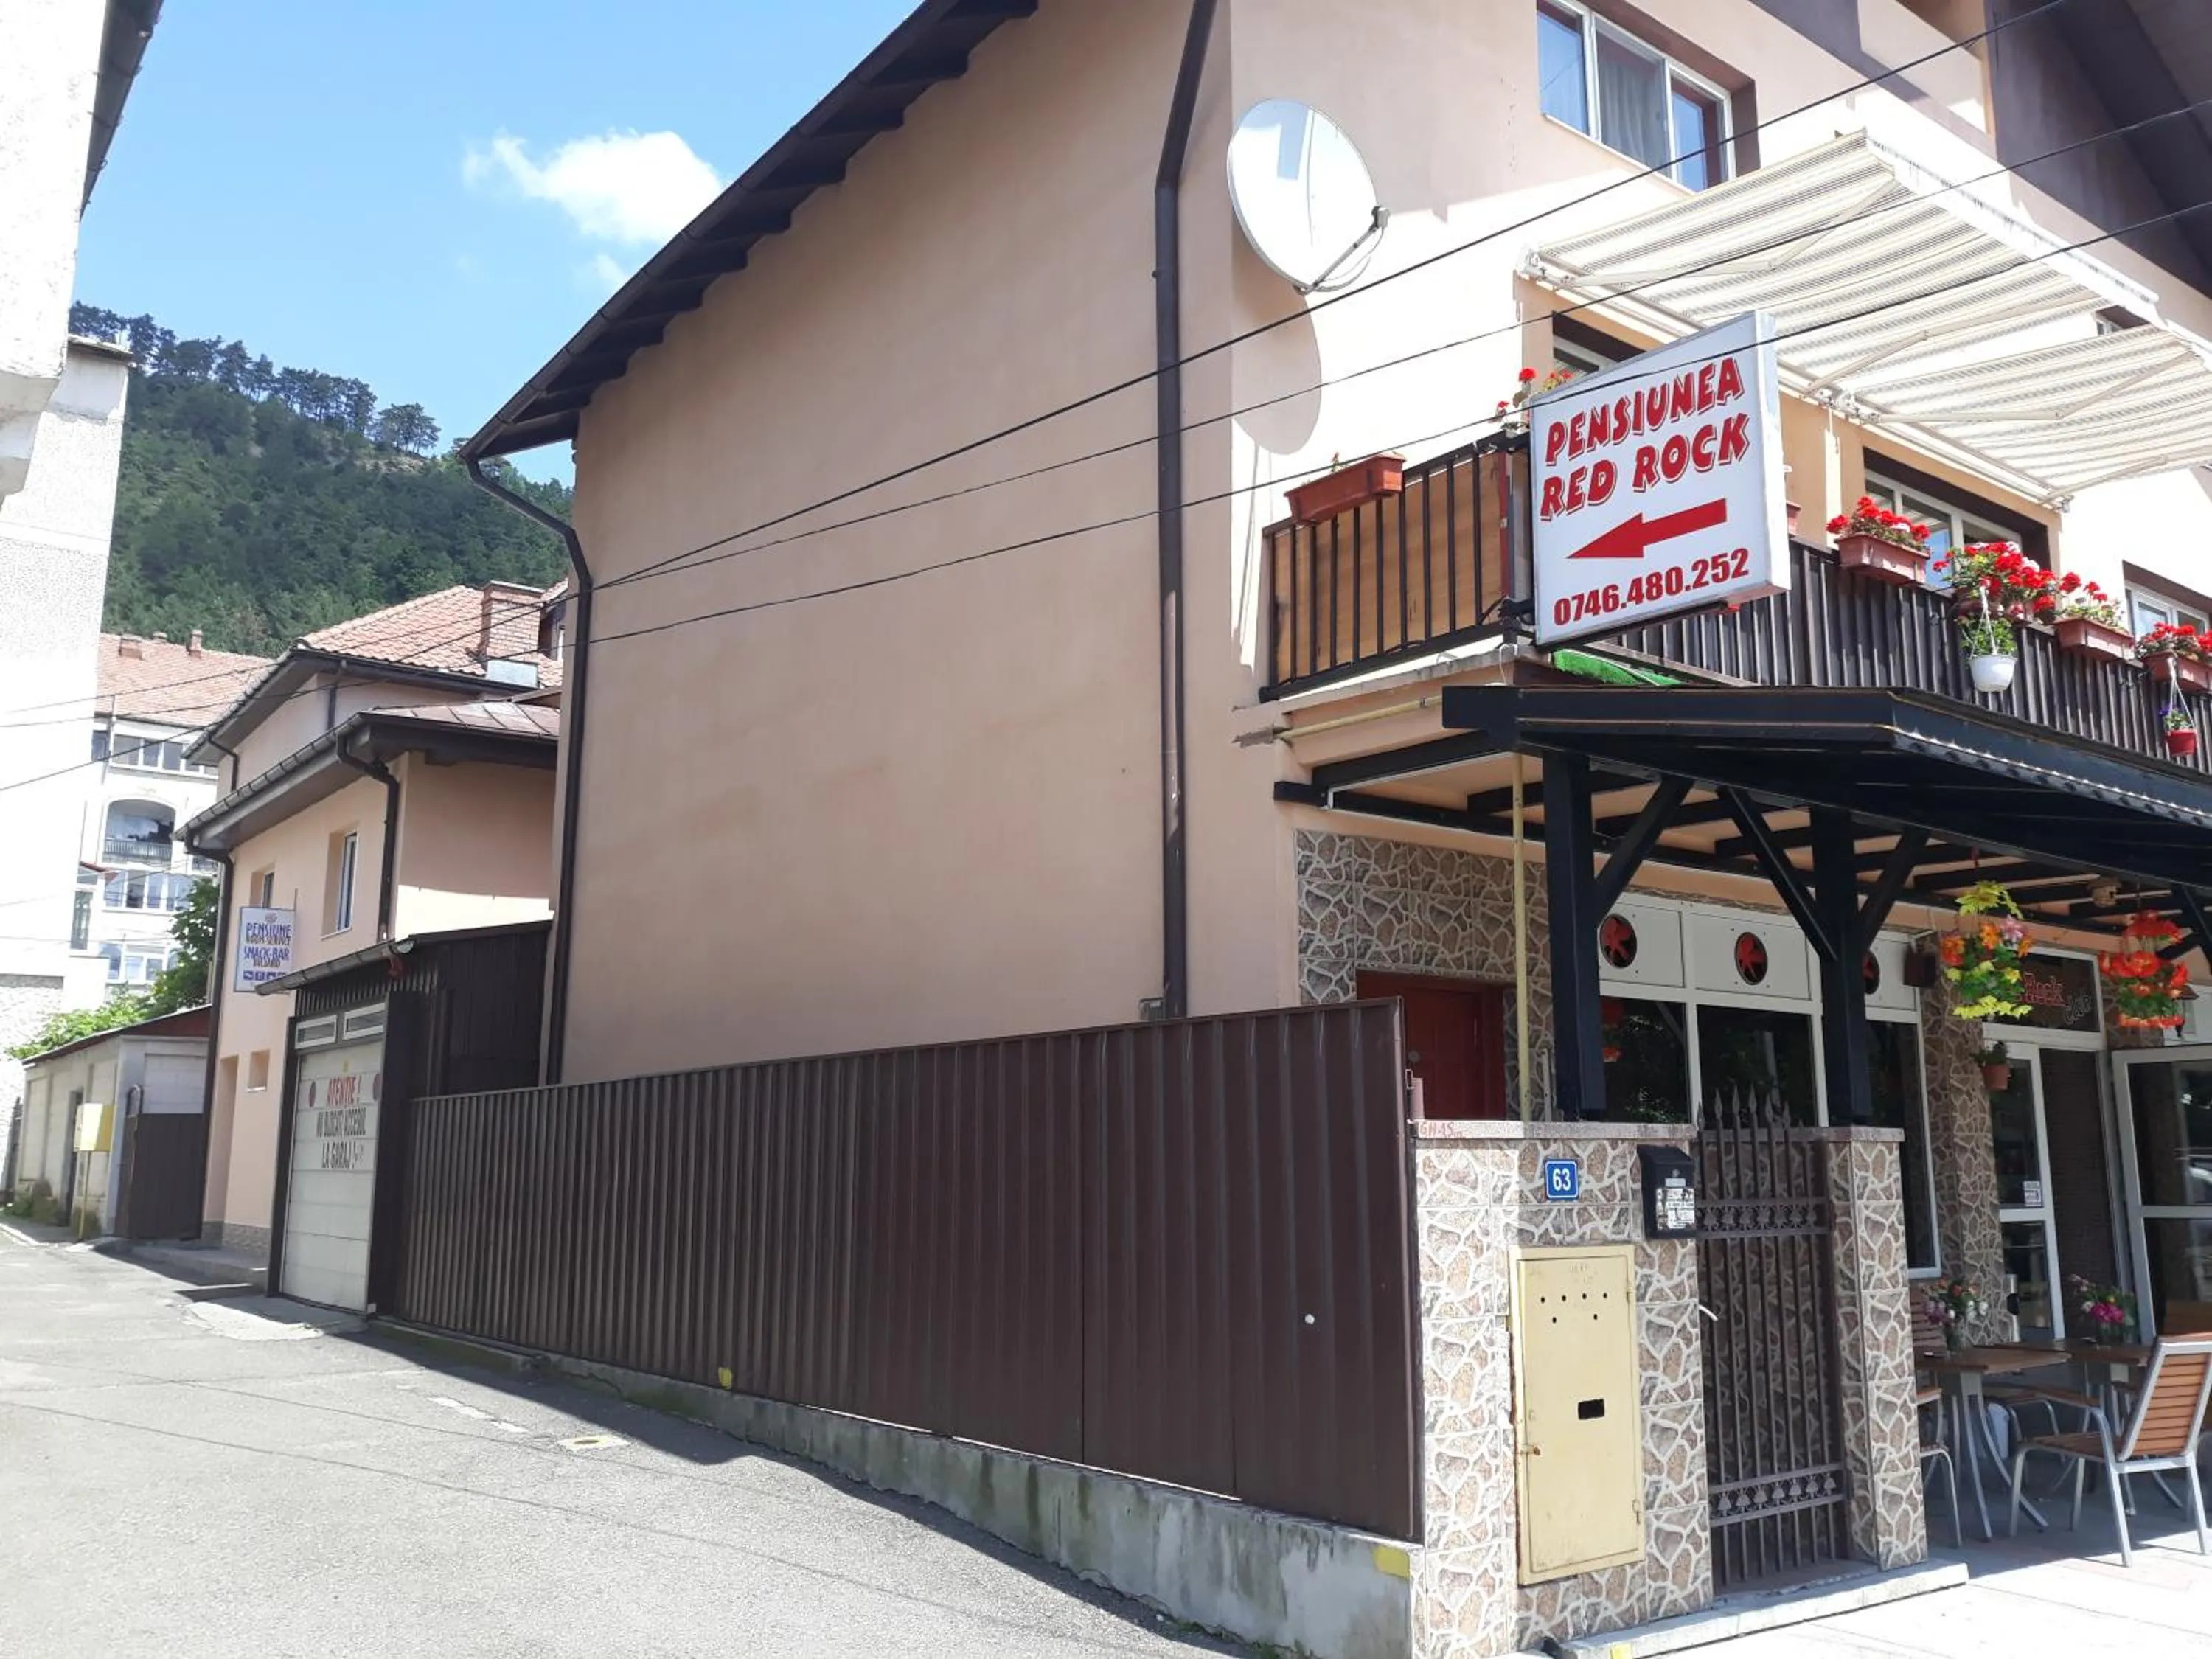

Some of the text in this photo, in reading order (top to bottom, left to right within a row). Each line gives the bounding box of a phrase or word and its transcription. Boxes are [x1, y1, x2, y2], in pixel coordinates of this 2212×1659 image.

[1545, 357, 1745, 466] PENSIUNEA
[1540, 412, 1750, 521] RED ROCK
[1554, 547, 1749, 626] 0746.480.252
[244, 946, 289, 960] SNACK-BAR
[246, 922, 291, 938] PENSIUNE
[1552, 1167, 1571, 1192] 63
